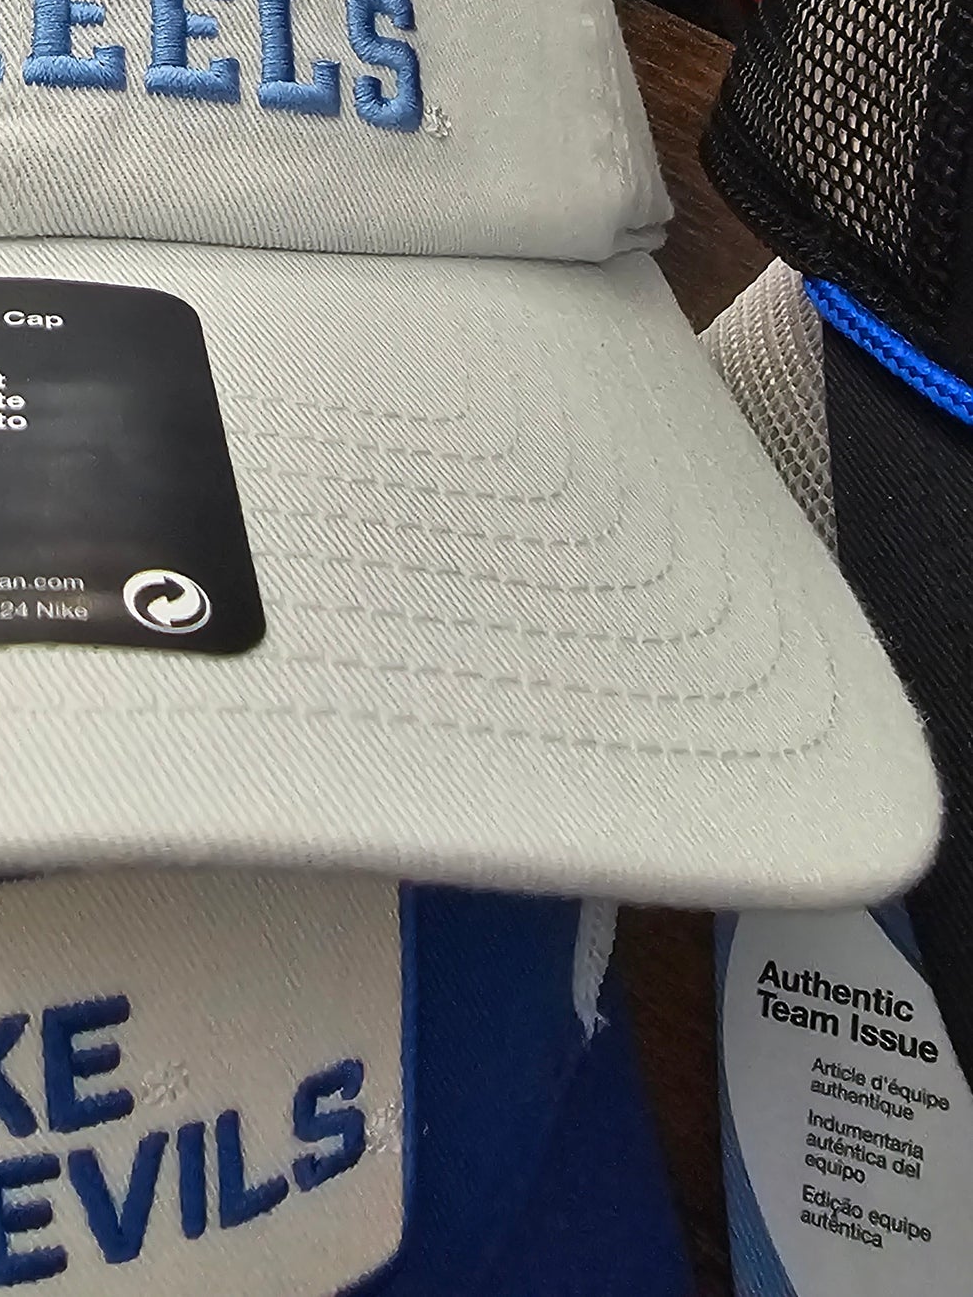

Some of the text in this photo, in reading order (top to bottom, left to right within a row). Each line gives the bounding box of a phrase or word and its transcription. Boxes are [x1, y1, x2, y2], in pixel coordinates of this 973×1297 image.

[3, 310, 65, 330] Cap
[37, 601, 89, 622] Nike
[757, 960, 915, 1022] Authentic
[756, 989, 939, 1063] Team Issue
[810, 1079, 915, 1120] authentique
[811, 1057, 950, 1111] Article d'équipe
[806, 1131, 921, 1180] auténtica del
[807, 1109, 924, 1161] Indumentaria
[805, 1152, 866, 1184] equipo
[802, 1185, 932, 1243] Edição equipe
